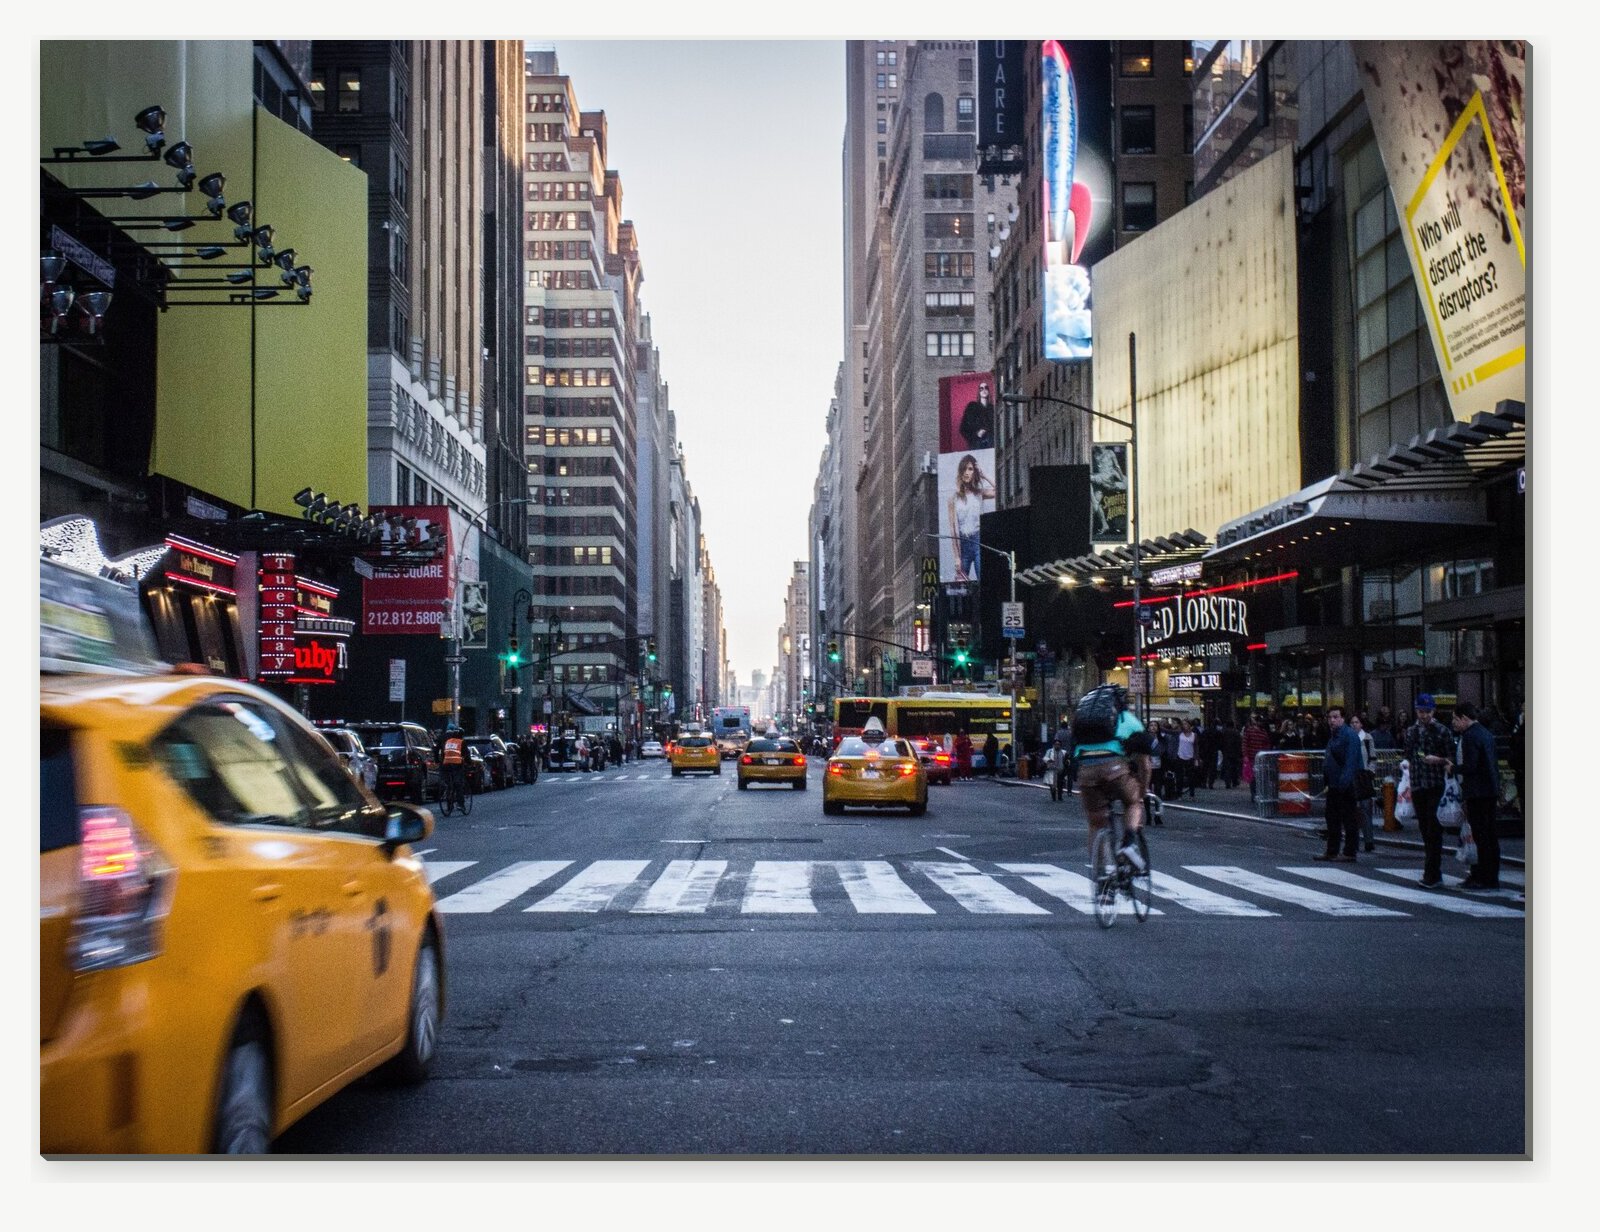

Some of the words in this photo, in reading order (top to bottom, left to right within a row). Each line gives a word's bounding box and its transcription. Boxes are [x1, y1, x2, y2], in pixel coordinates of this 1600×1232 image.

[1417, 221, 1442, 252] Who
[1441, 191, 1462, 235] will
[1429, 241, 1466, 287] disrupt
[1464, 232, 1487, 261] the
[1438, 261, 1498, 321] disruptors?
[274, 557, 287, 669] Tuesday
[368, 611, 443, 626] 212.812.5808
[1005, 616, 1021, 626] 25
[1176, 595, 1249, 637] LOBSTER
[293, 640, 336, 676] uby
[1176, 647, 1190, 658] FISH
[1192, 645, 1205, 658] LIVE
[1206, 642, 1232, 657] LOBSTER
[1175, 675, 1193, 687] FISH
